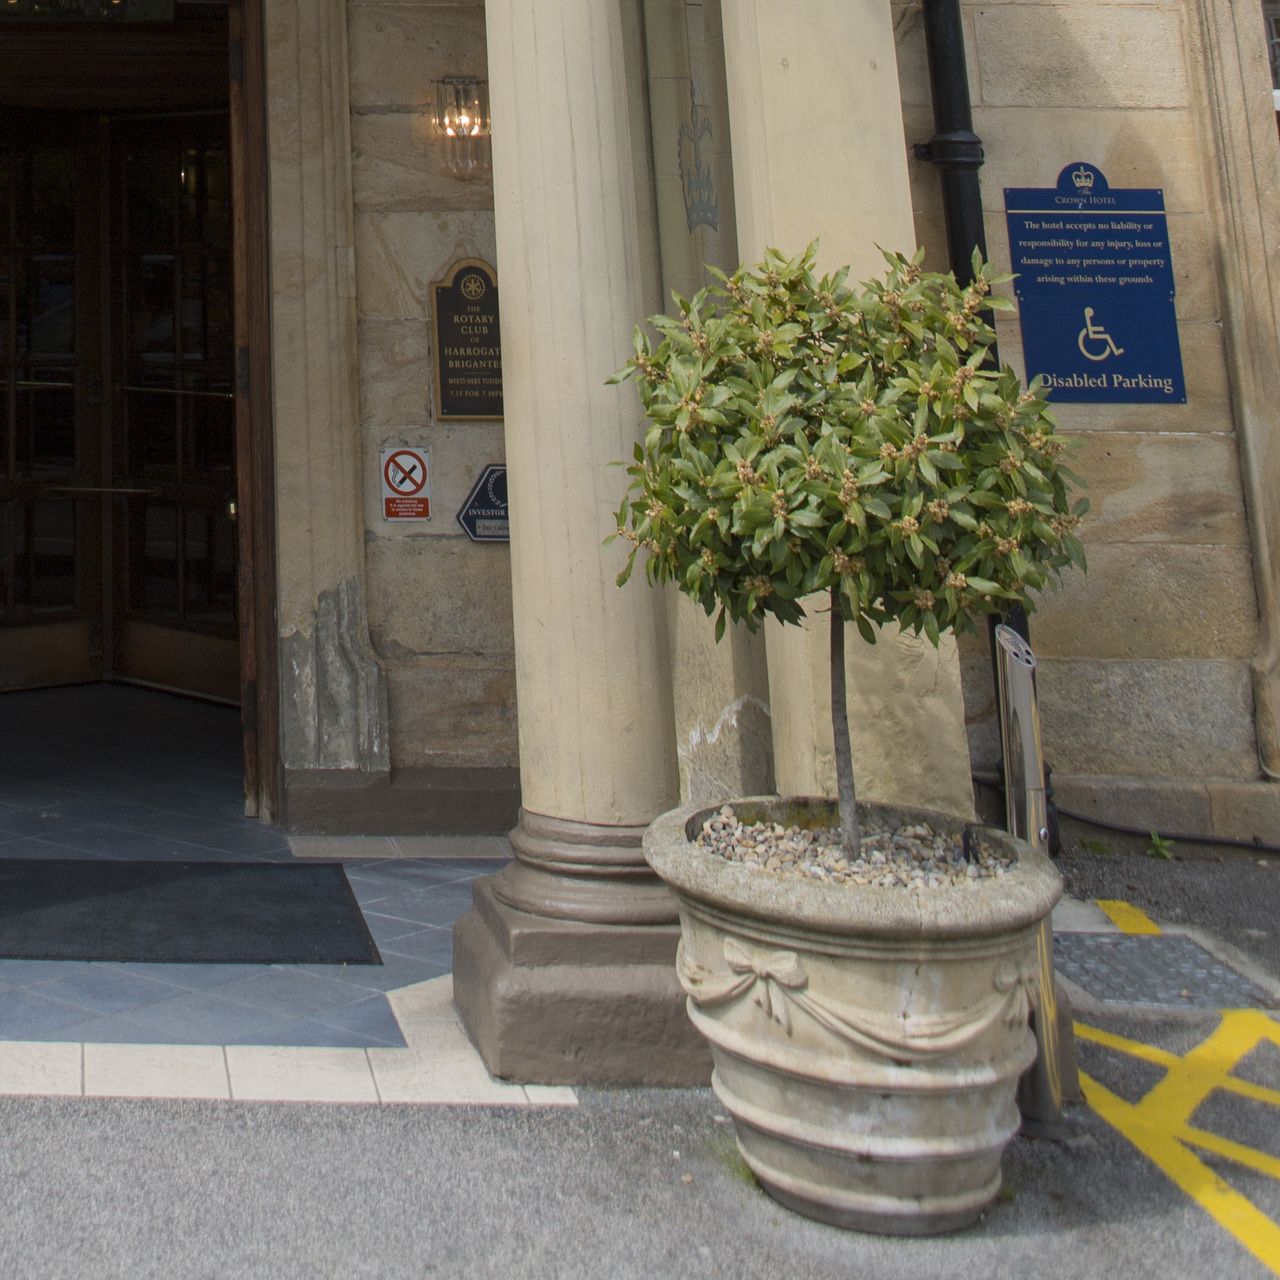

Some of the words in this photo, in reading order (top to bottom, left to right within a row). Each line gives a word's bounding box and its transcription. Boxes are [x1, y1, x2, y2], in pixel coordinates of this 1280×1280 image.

[1055, 196, 1087, 204] CROWN
[1090, 196, 1116, 205] HOTEL
[1024, 221, 1040, 230] The
[1042, 221, 1064, 230] hotel
[1065, 222, 1096, 232] accepts
[1111, 222, 1142, 232] liability
[1018, 239, 1074, 249] responsibility
[1075, 239, 1088, 247] for
[1090, 241, 1105, 250] any
[1107, 240, 1134, 250] injury,
[1020, 257, 1054, 267] damage
[1066, 259, 1081, 268] any
[1082, 259, 1115, 268] persons
[1128, 258, 1165, 268] property
[1036, 275, 1065, 286] arising
[1067, 275, 1093, 283] within
[1095, 275, 1117, 283] these
[1118, 275, 1153, 286] grounds
[453, 314, 494, 323] ROTARY
[460, 325, 488, 335] CLUB
[444, 347, 500, 356] HARROGAT
[1040, 373, 1108, 389] Disabled
[1113, 374, 1174, 394] Parking
[469, 509, 506, 517] INVESTOR
